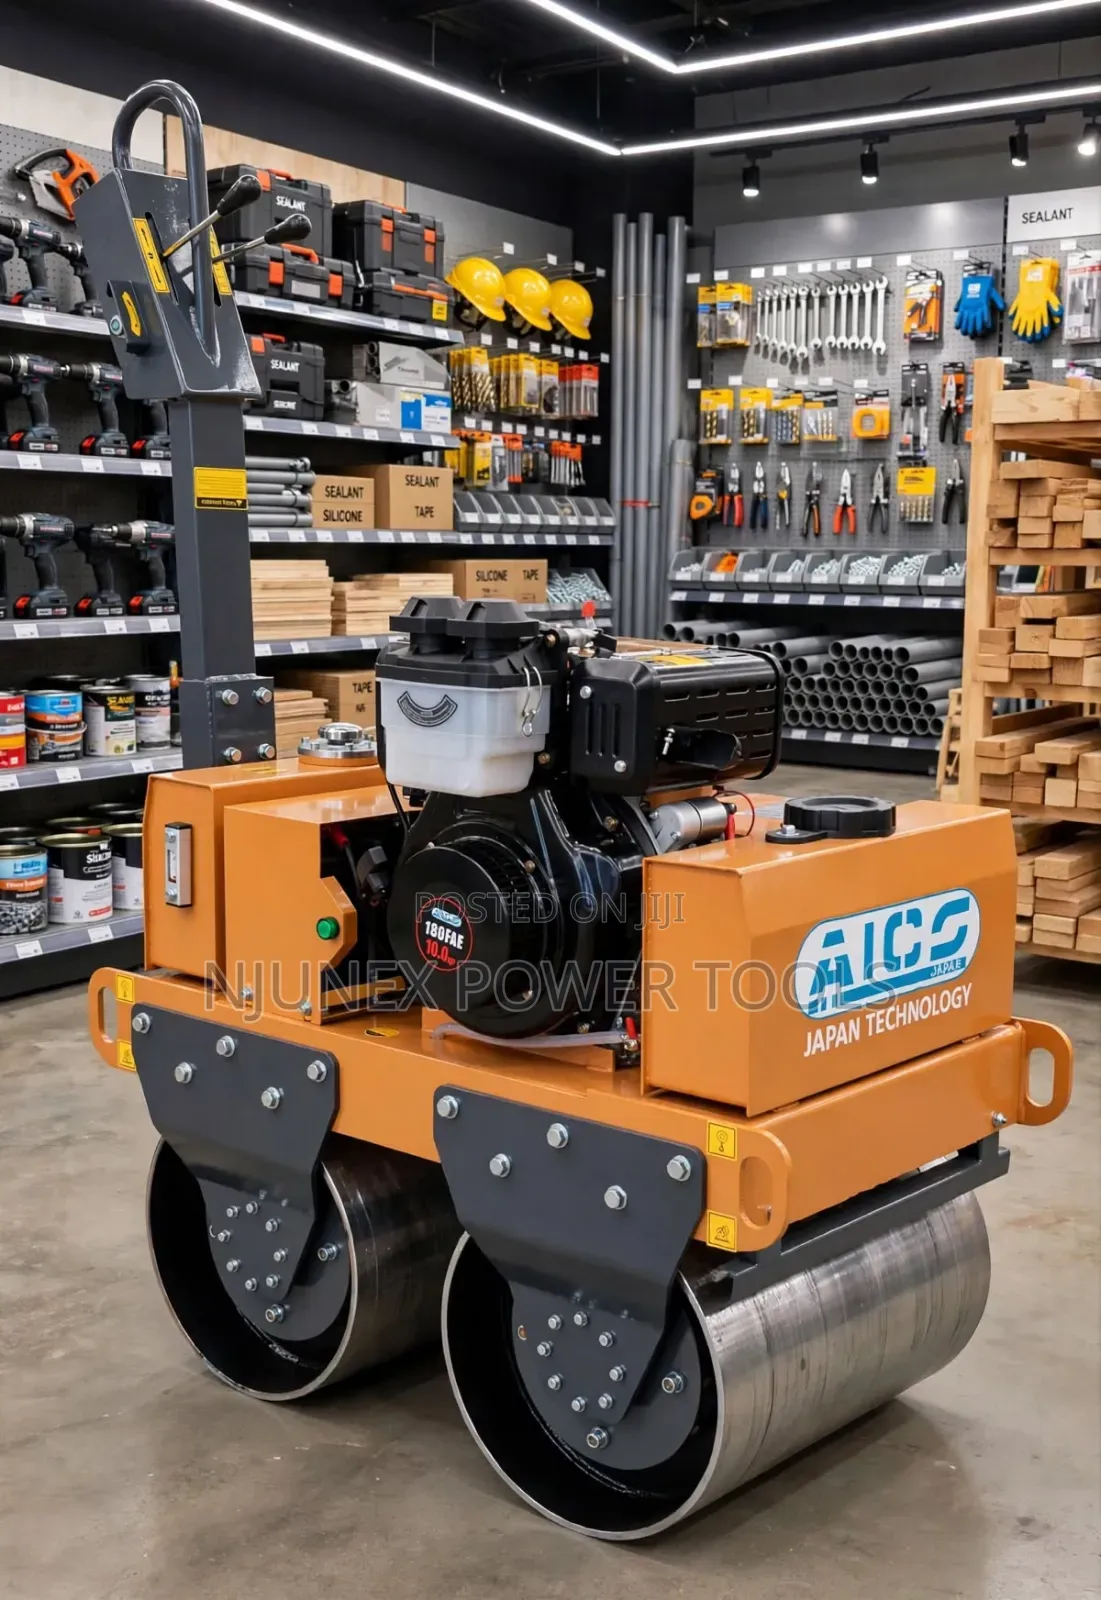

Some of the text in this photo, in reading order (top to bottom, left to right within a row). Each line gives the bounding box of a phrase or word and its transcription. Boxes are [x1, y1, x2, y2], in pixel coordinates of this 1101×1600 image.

[276, 195, 306, 212] SEALANT
[1022, 207, 1074, 224] SEALANT
[270, 359, 300, 372] SEALANT
[405, 474, 440, 488] SEALANT
[325, 485, 364, 498] SEALANT
[323, 509, 363, 522] SILICONE
[415, 505, 434, 518] TAPE
[475, 568, 539, 582] SILICONE TAPE
[352, 682, 373, 693] TAPE
[425, 921, 464, 950] 180FAE
[808, 896, 970, 996] AICS
[804, 983, 972, 1057] JAPAN TECHNOLOGY
